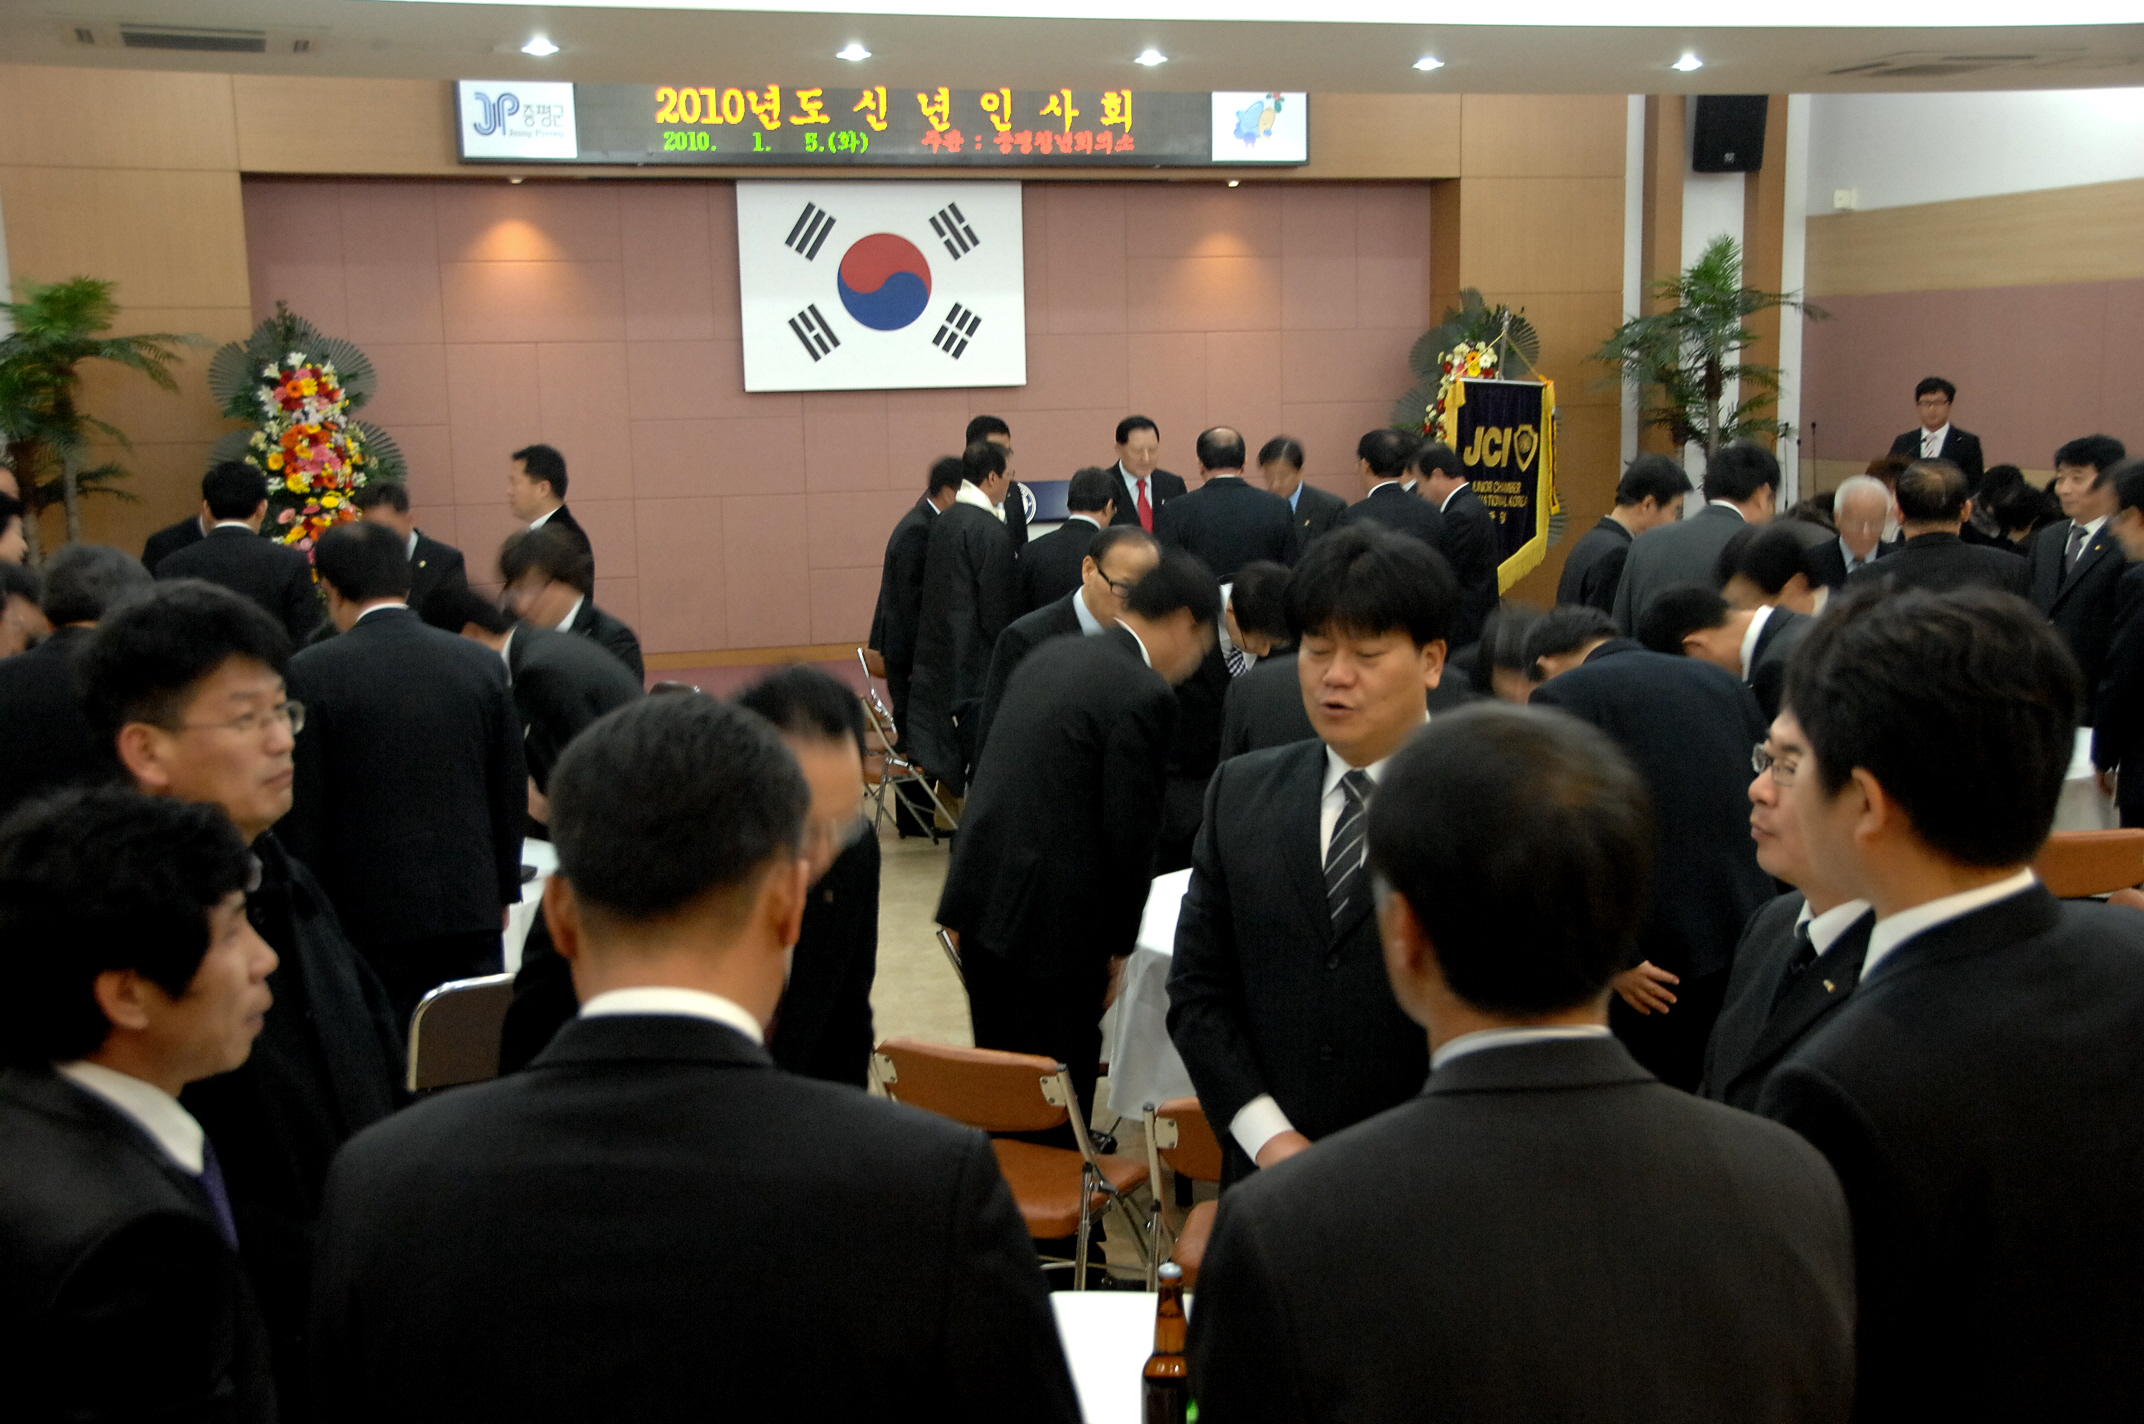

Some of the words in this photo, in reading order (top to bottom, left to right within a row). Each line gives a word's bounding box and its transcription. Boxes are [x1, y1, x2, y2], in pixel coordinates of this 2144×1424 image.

[523, 104, 564, 128] 증평군
[655, 84, 831, 130] 2010년도
[663, 131, 717, 152] 2010.
[752, 131, 772, 152] 1.
[1463, 426, 1512, 468] JCI
